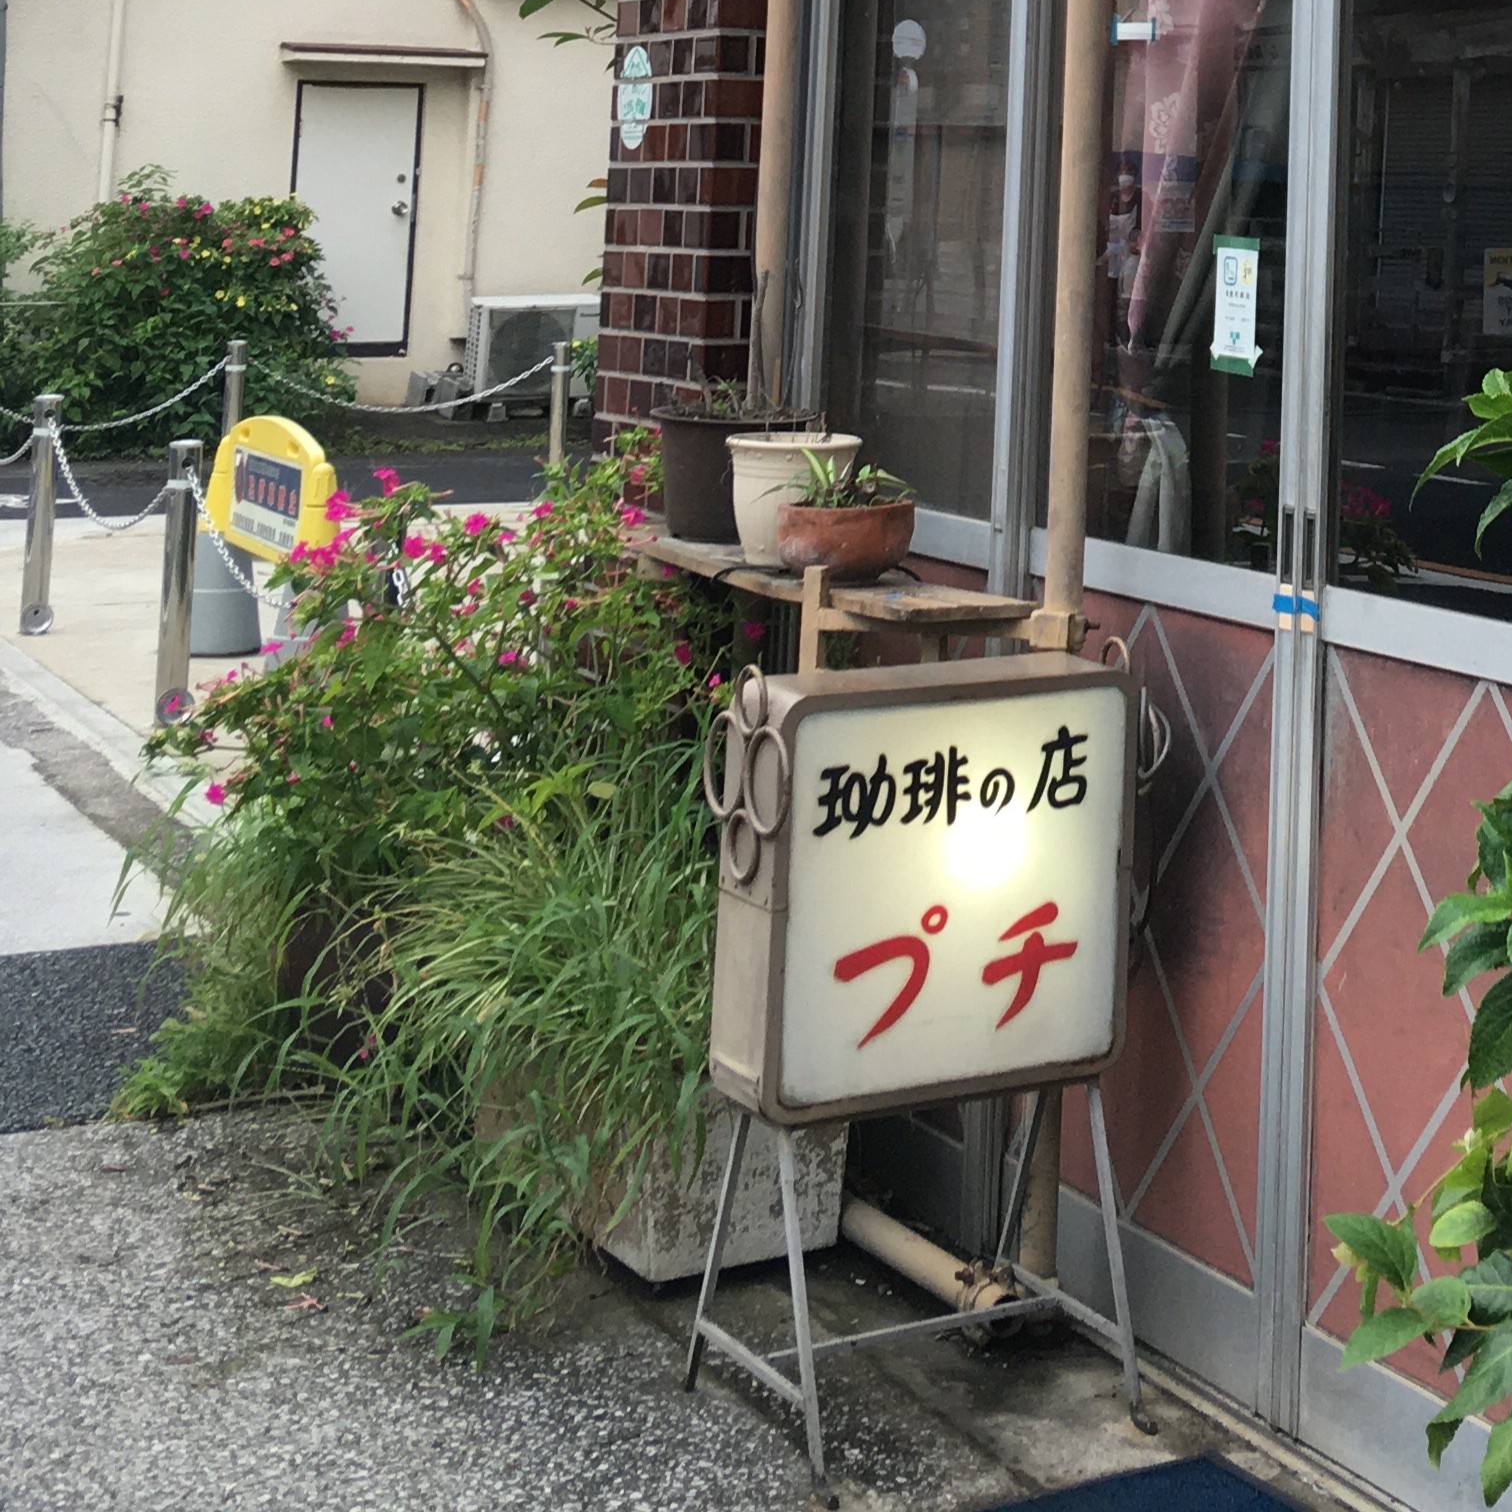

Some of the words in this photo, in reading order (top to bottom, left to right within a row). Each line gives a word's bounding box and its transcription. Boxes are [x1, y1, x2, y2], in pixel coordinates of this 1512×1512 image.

[812, 724, 1090, 840] 珈琲の店
[833, 900, 1079, 1050] プチ
